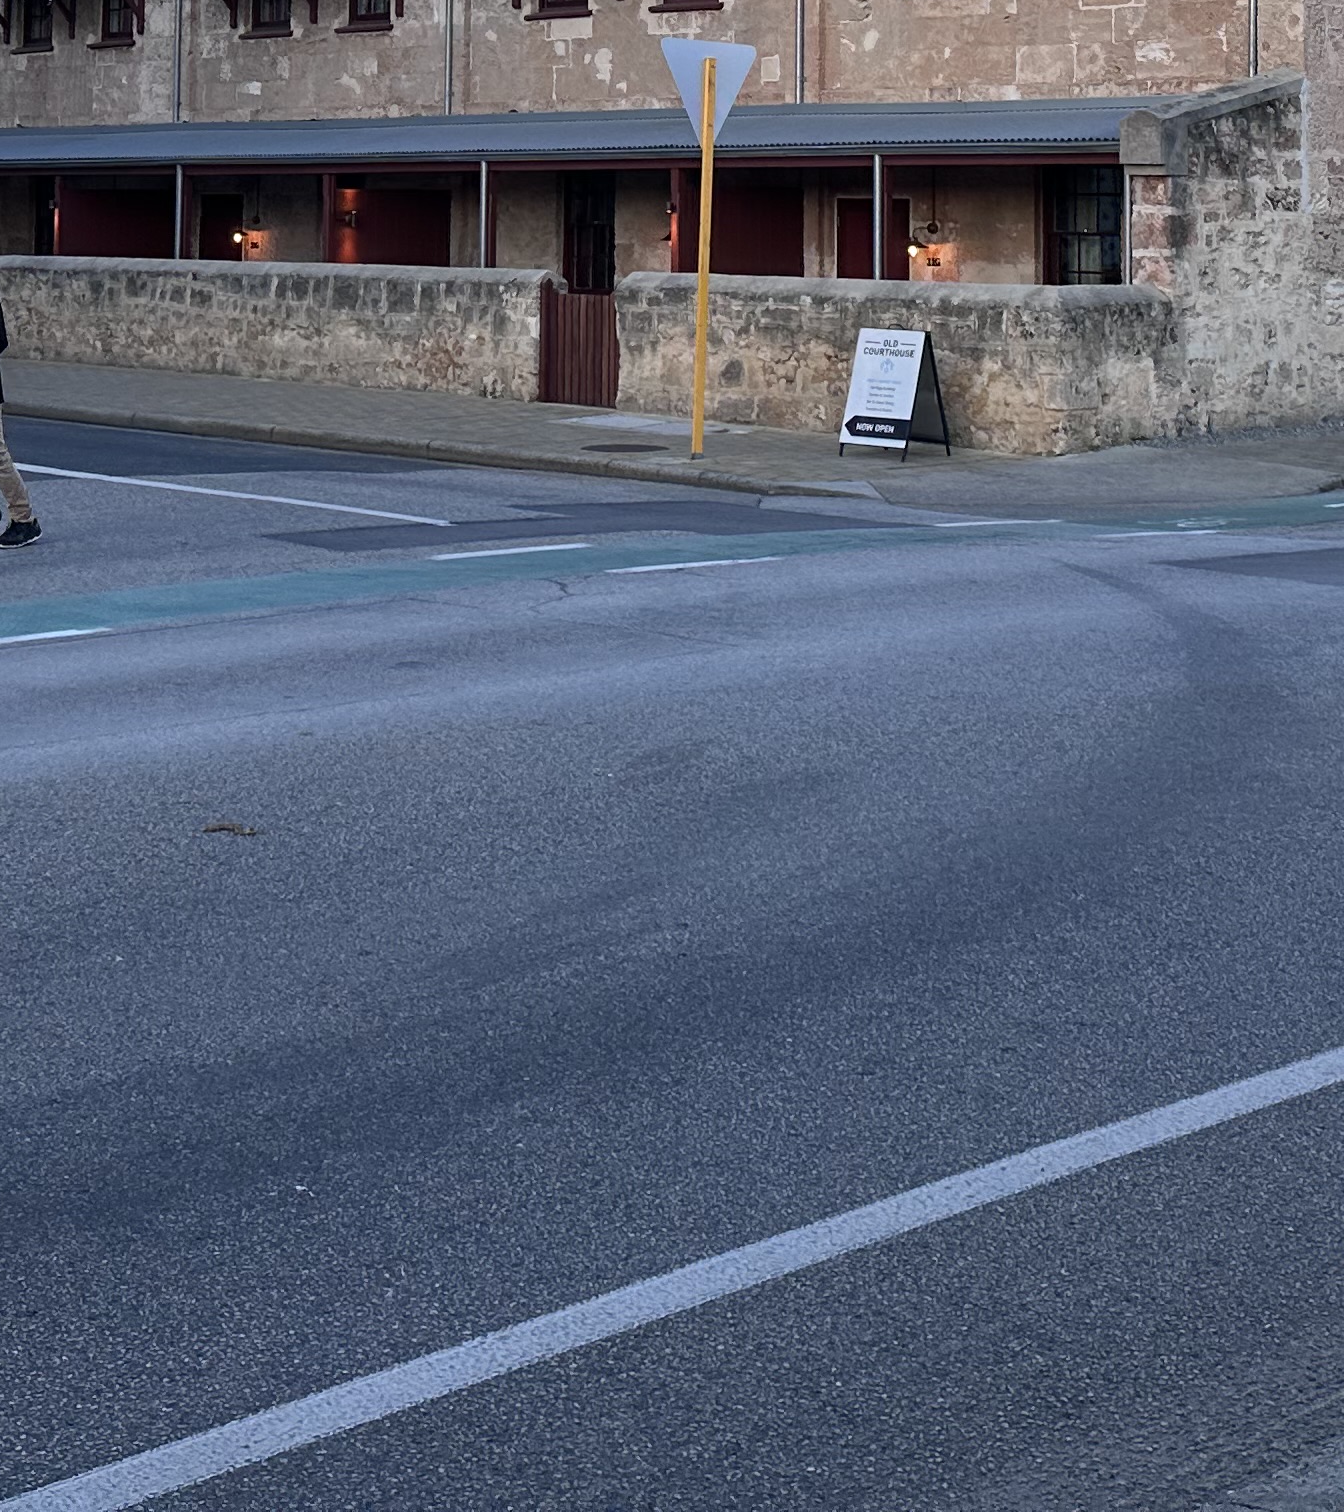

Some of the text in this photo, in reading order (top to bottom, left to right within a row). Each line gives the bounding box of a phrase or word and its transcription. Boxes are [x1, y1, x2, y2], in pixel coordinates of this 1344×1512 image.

[883, 339, 899, 348] OLD
[863, 347, 916, 358] COURTHOUSE
[856, 422, 895, 434] NOW OPEN
